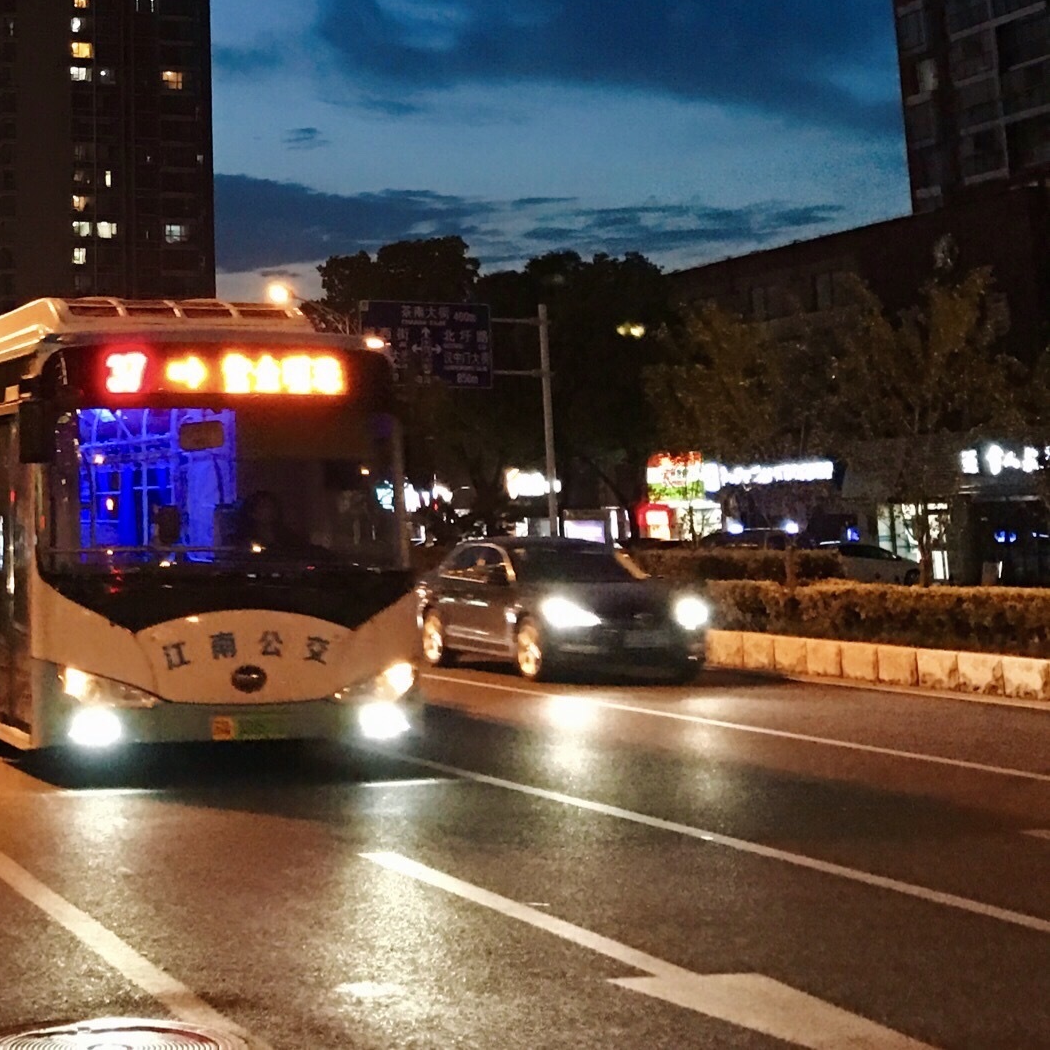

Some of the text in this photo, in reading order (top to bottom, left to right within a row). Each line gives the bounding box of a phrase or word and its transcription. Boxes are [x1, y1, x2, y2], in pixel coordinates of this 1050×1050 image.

[400, 304, 450, 320] 茶南大街
[161, 630, 331, 671] 江南公交
